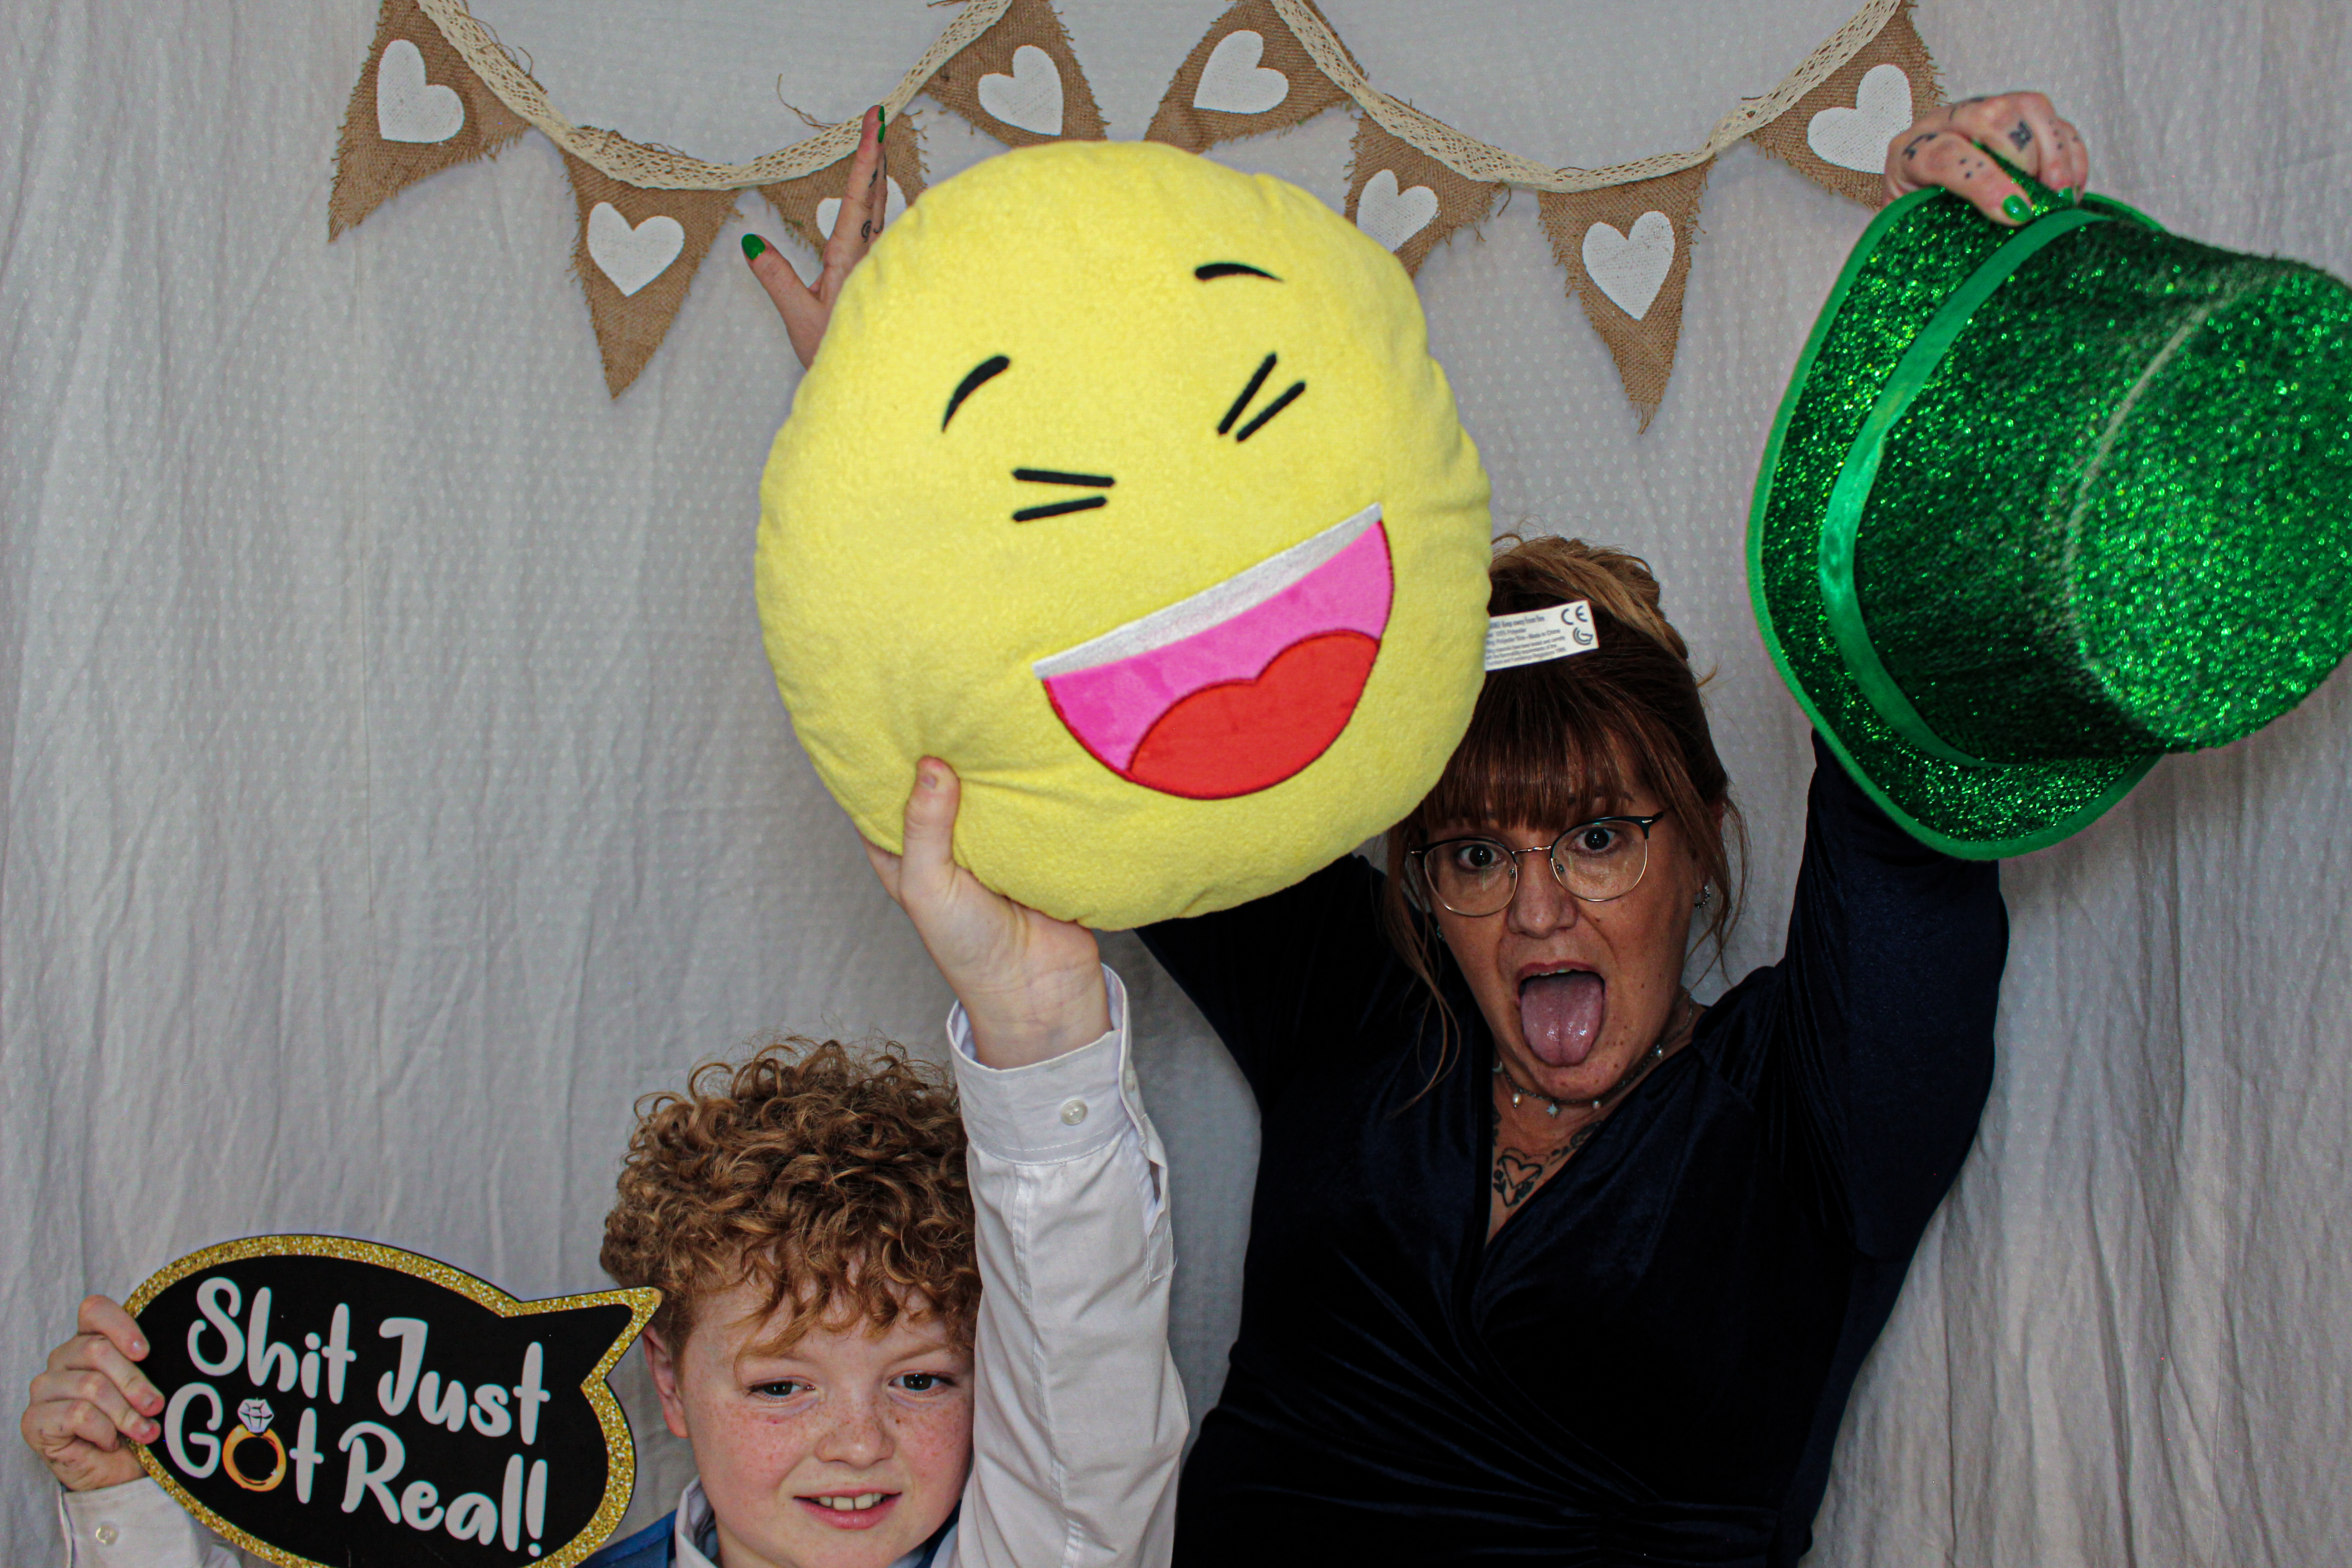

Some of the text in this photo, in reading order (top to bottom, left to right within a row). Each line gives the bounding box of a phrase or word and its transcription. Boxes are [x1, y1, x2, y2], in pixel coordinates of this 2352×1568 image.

[187, 1277, 550, 1445] Shit Just
[165, 1382, 548, 1557] Got Real!
